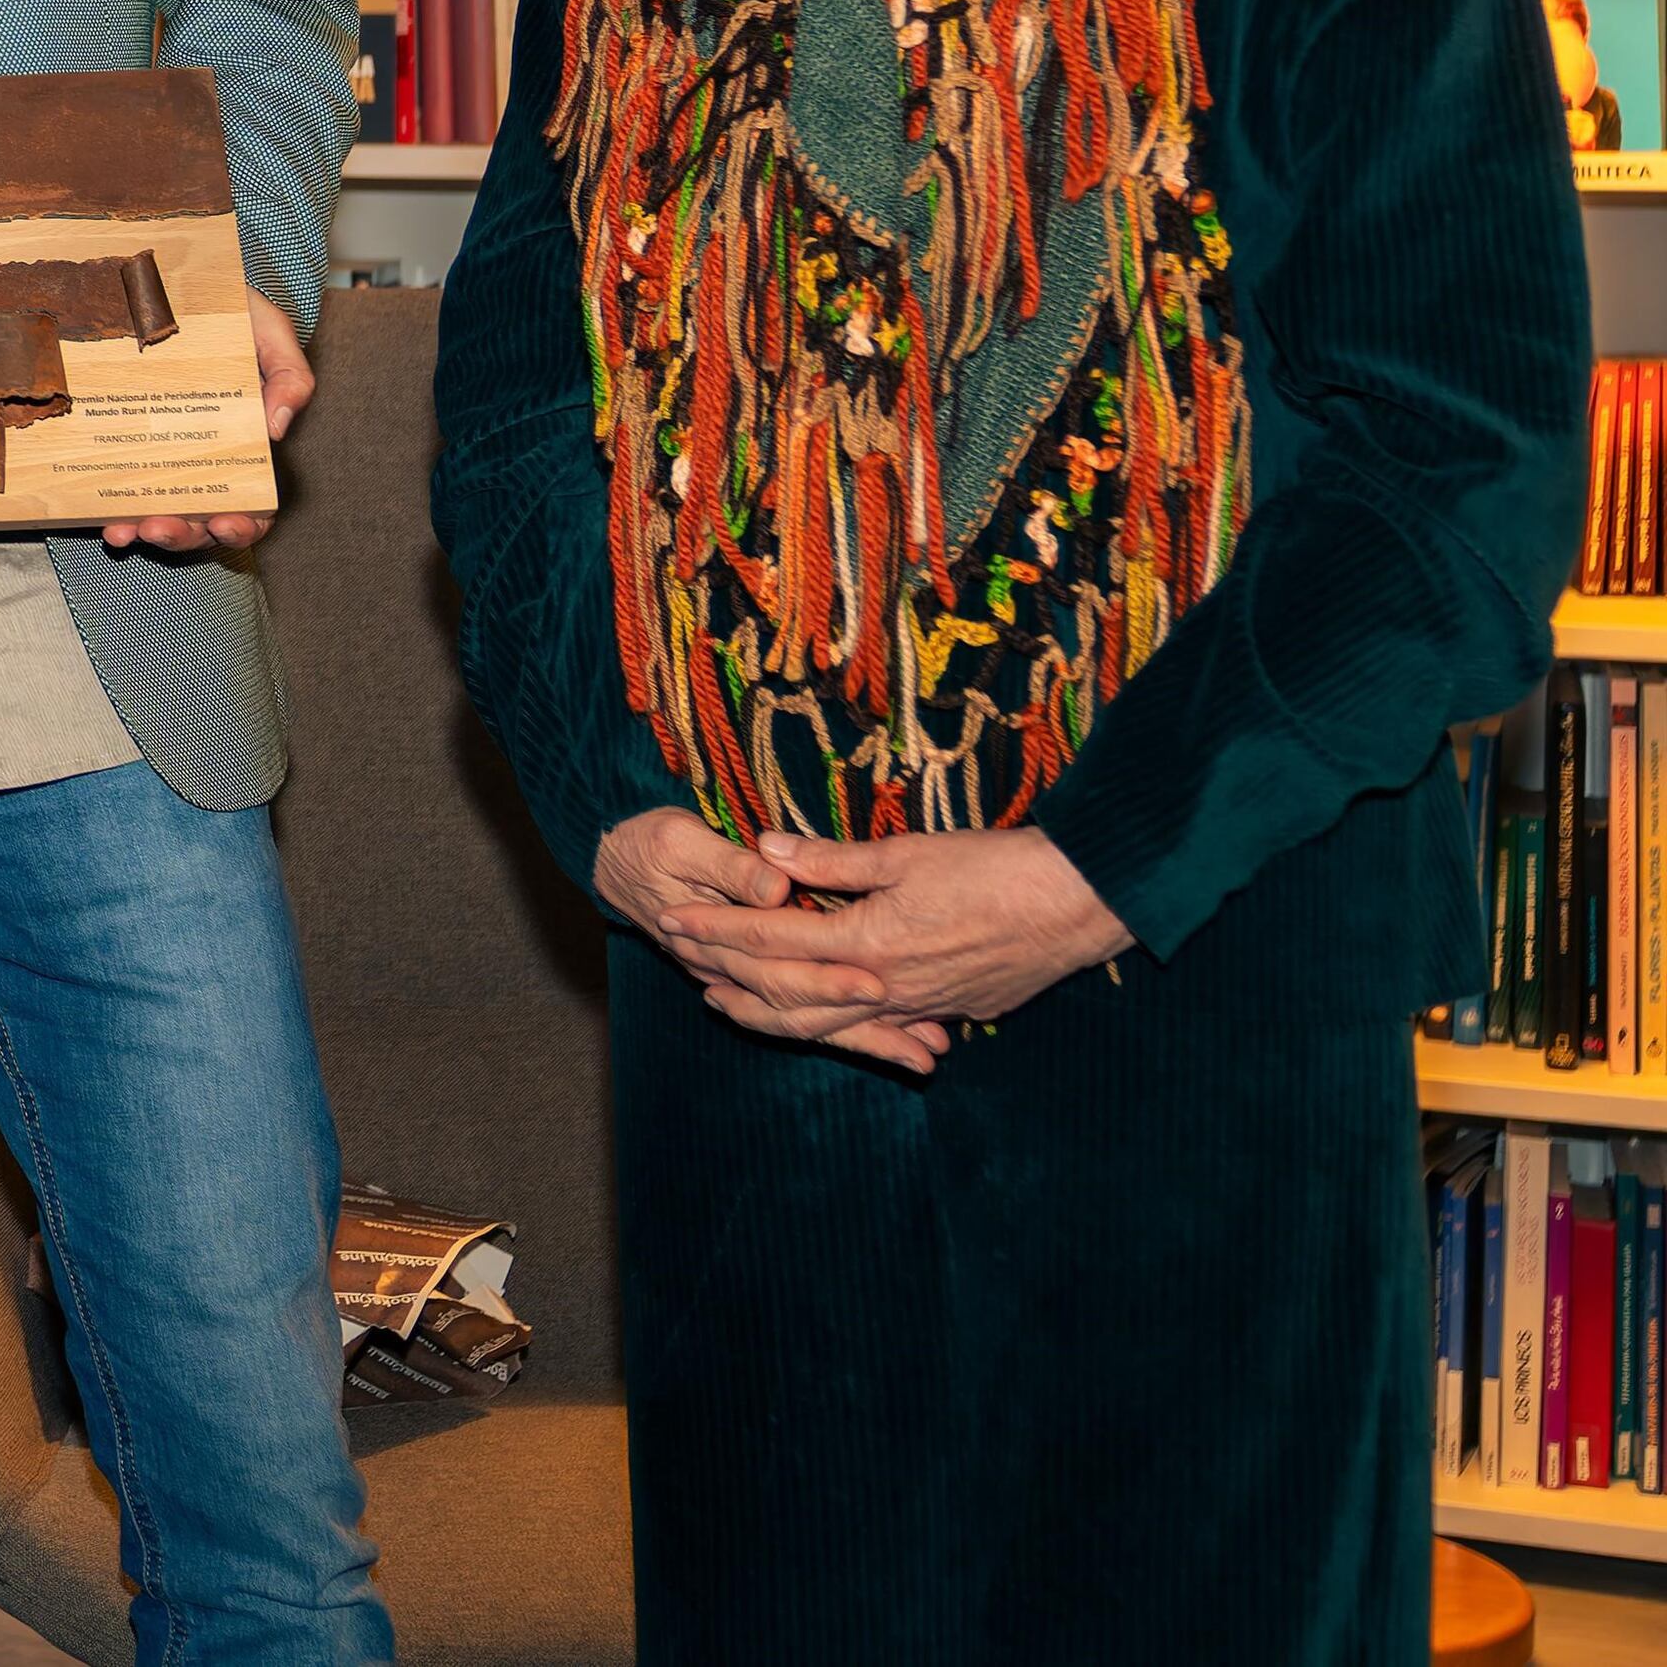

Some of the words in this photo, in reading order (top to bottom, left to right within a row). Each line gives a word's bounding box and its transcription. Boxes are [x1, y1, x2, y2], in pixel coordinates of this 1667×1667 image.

[72, 395, 104, 404] Premio
[107, 393, 148, 402] Nacional
[151, 393, 162, 401] de
[164, 391, 217, 401] Periodismo
[219, 391, 232, 399] en
[234, 390, 243, 398] el
[85, 407, 119, 417] Mundo
[121, 406, 147, 415] Rural
[149, 404, 182, 414] Ainhoa
[185, 404, 220, 413] Camino
[94, 433, 146, 444] FRANCISCO
[148, 431, 171, 442] JOSÉ
[173, 431, 219, 442] PORQUET
[53, 463, 64, 472] En
[67, 461, 139, 472] reconocimiento
[163, 457, 213, 470] trayectoria
[98, 487, 139, 498] Villanúa,
[141, 487, 152, 496] 26
[155, 486, 167, 495] de
[169, 485, 190, 495] abril
[192, 484, 203, 493] de
[206, 484, 229, 493] 2025
